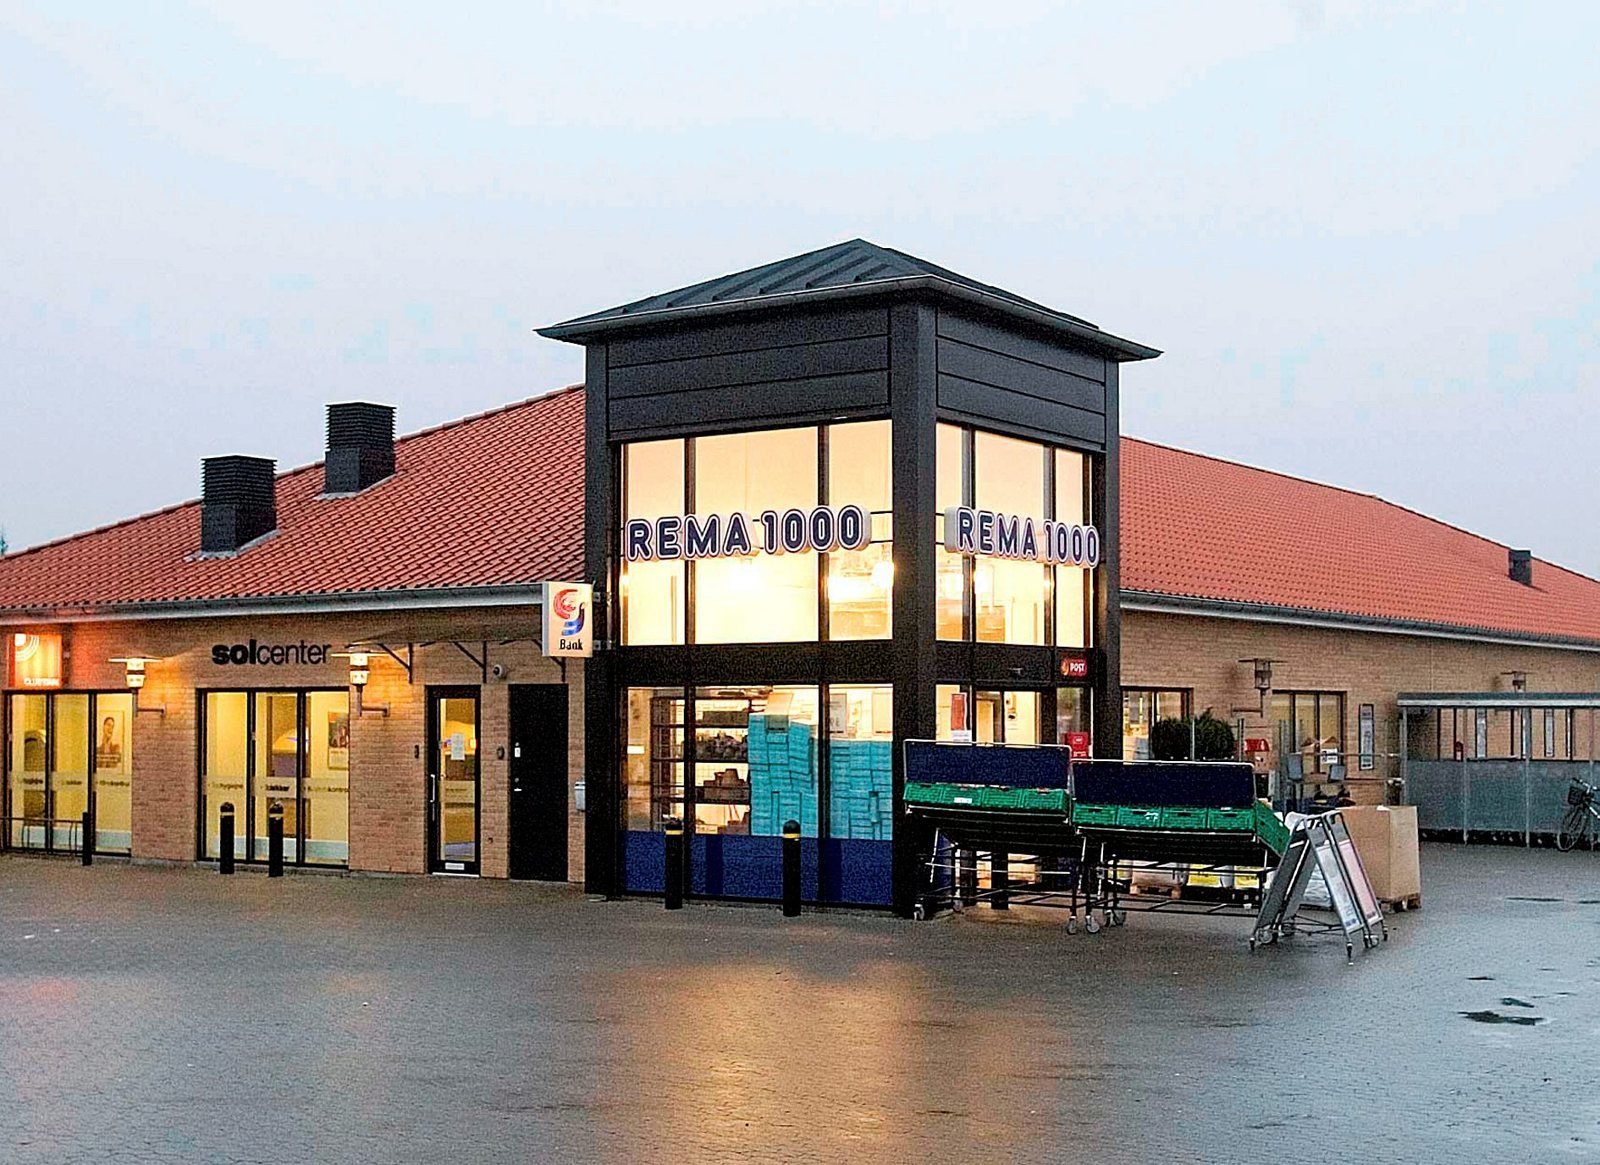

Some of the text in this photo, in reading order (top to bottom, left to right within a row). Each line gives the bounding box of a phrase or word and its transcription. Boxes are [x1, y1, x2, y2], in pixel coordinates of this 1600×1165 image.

[626, 504, 865, 561] REMA 1000
[957, 506, 1099, 568] REMA 1000
[211, 638, 331, 665] solcenter
[559, 638, 583, 650] Bank
[1069, 661, 1085, 674] POST
